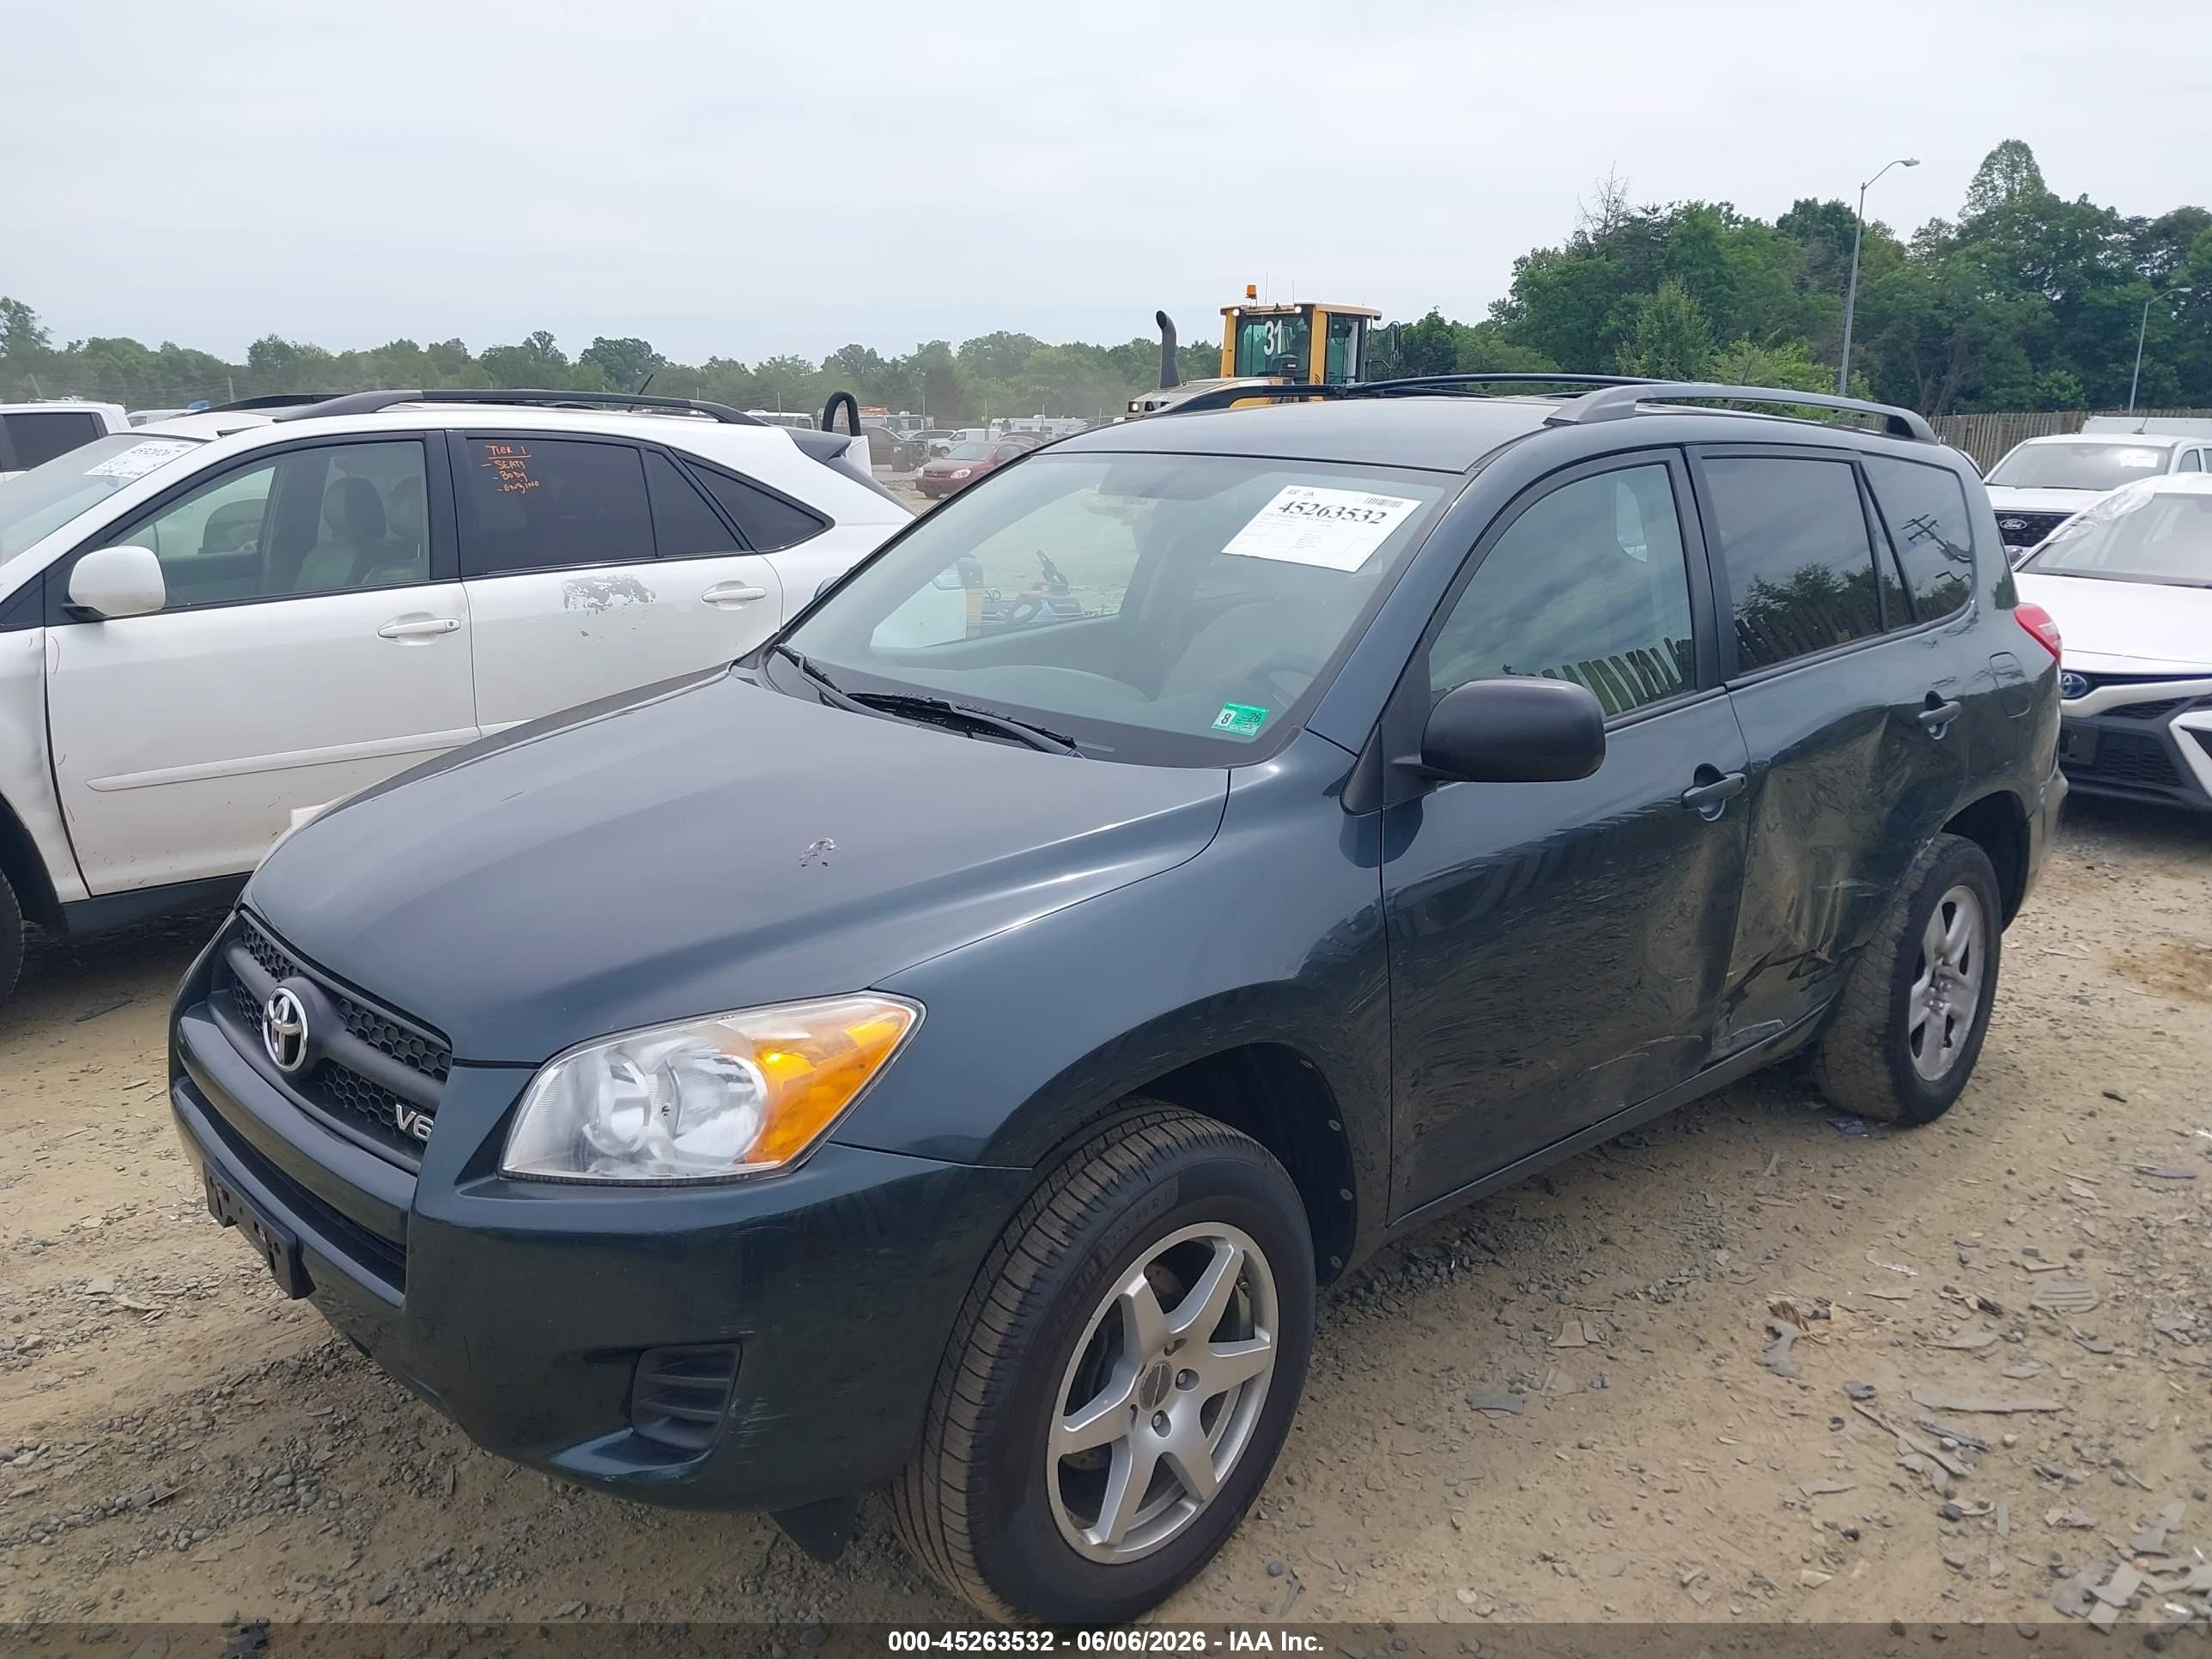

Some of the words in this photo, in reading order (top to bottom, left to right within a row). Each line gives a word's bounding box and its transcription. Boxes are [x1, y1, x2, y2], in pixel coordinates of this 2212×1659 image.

[1263, 319, 1283, 356] 31
[520, 446, 526, 455] 1
[1278, 501, 1388, 525] 45263532
[1220, 713, 1232, 725] 8
[396, 1103, 434, 1141] V6
